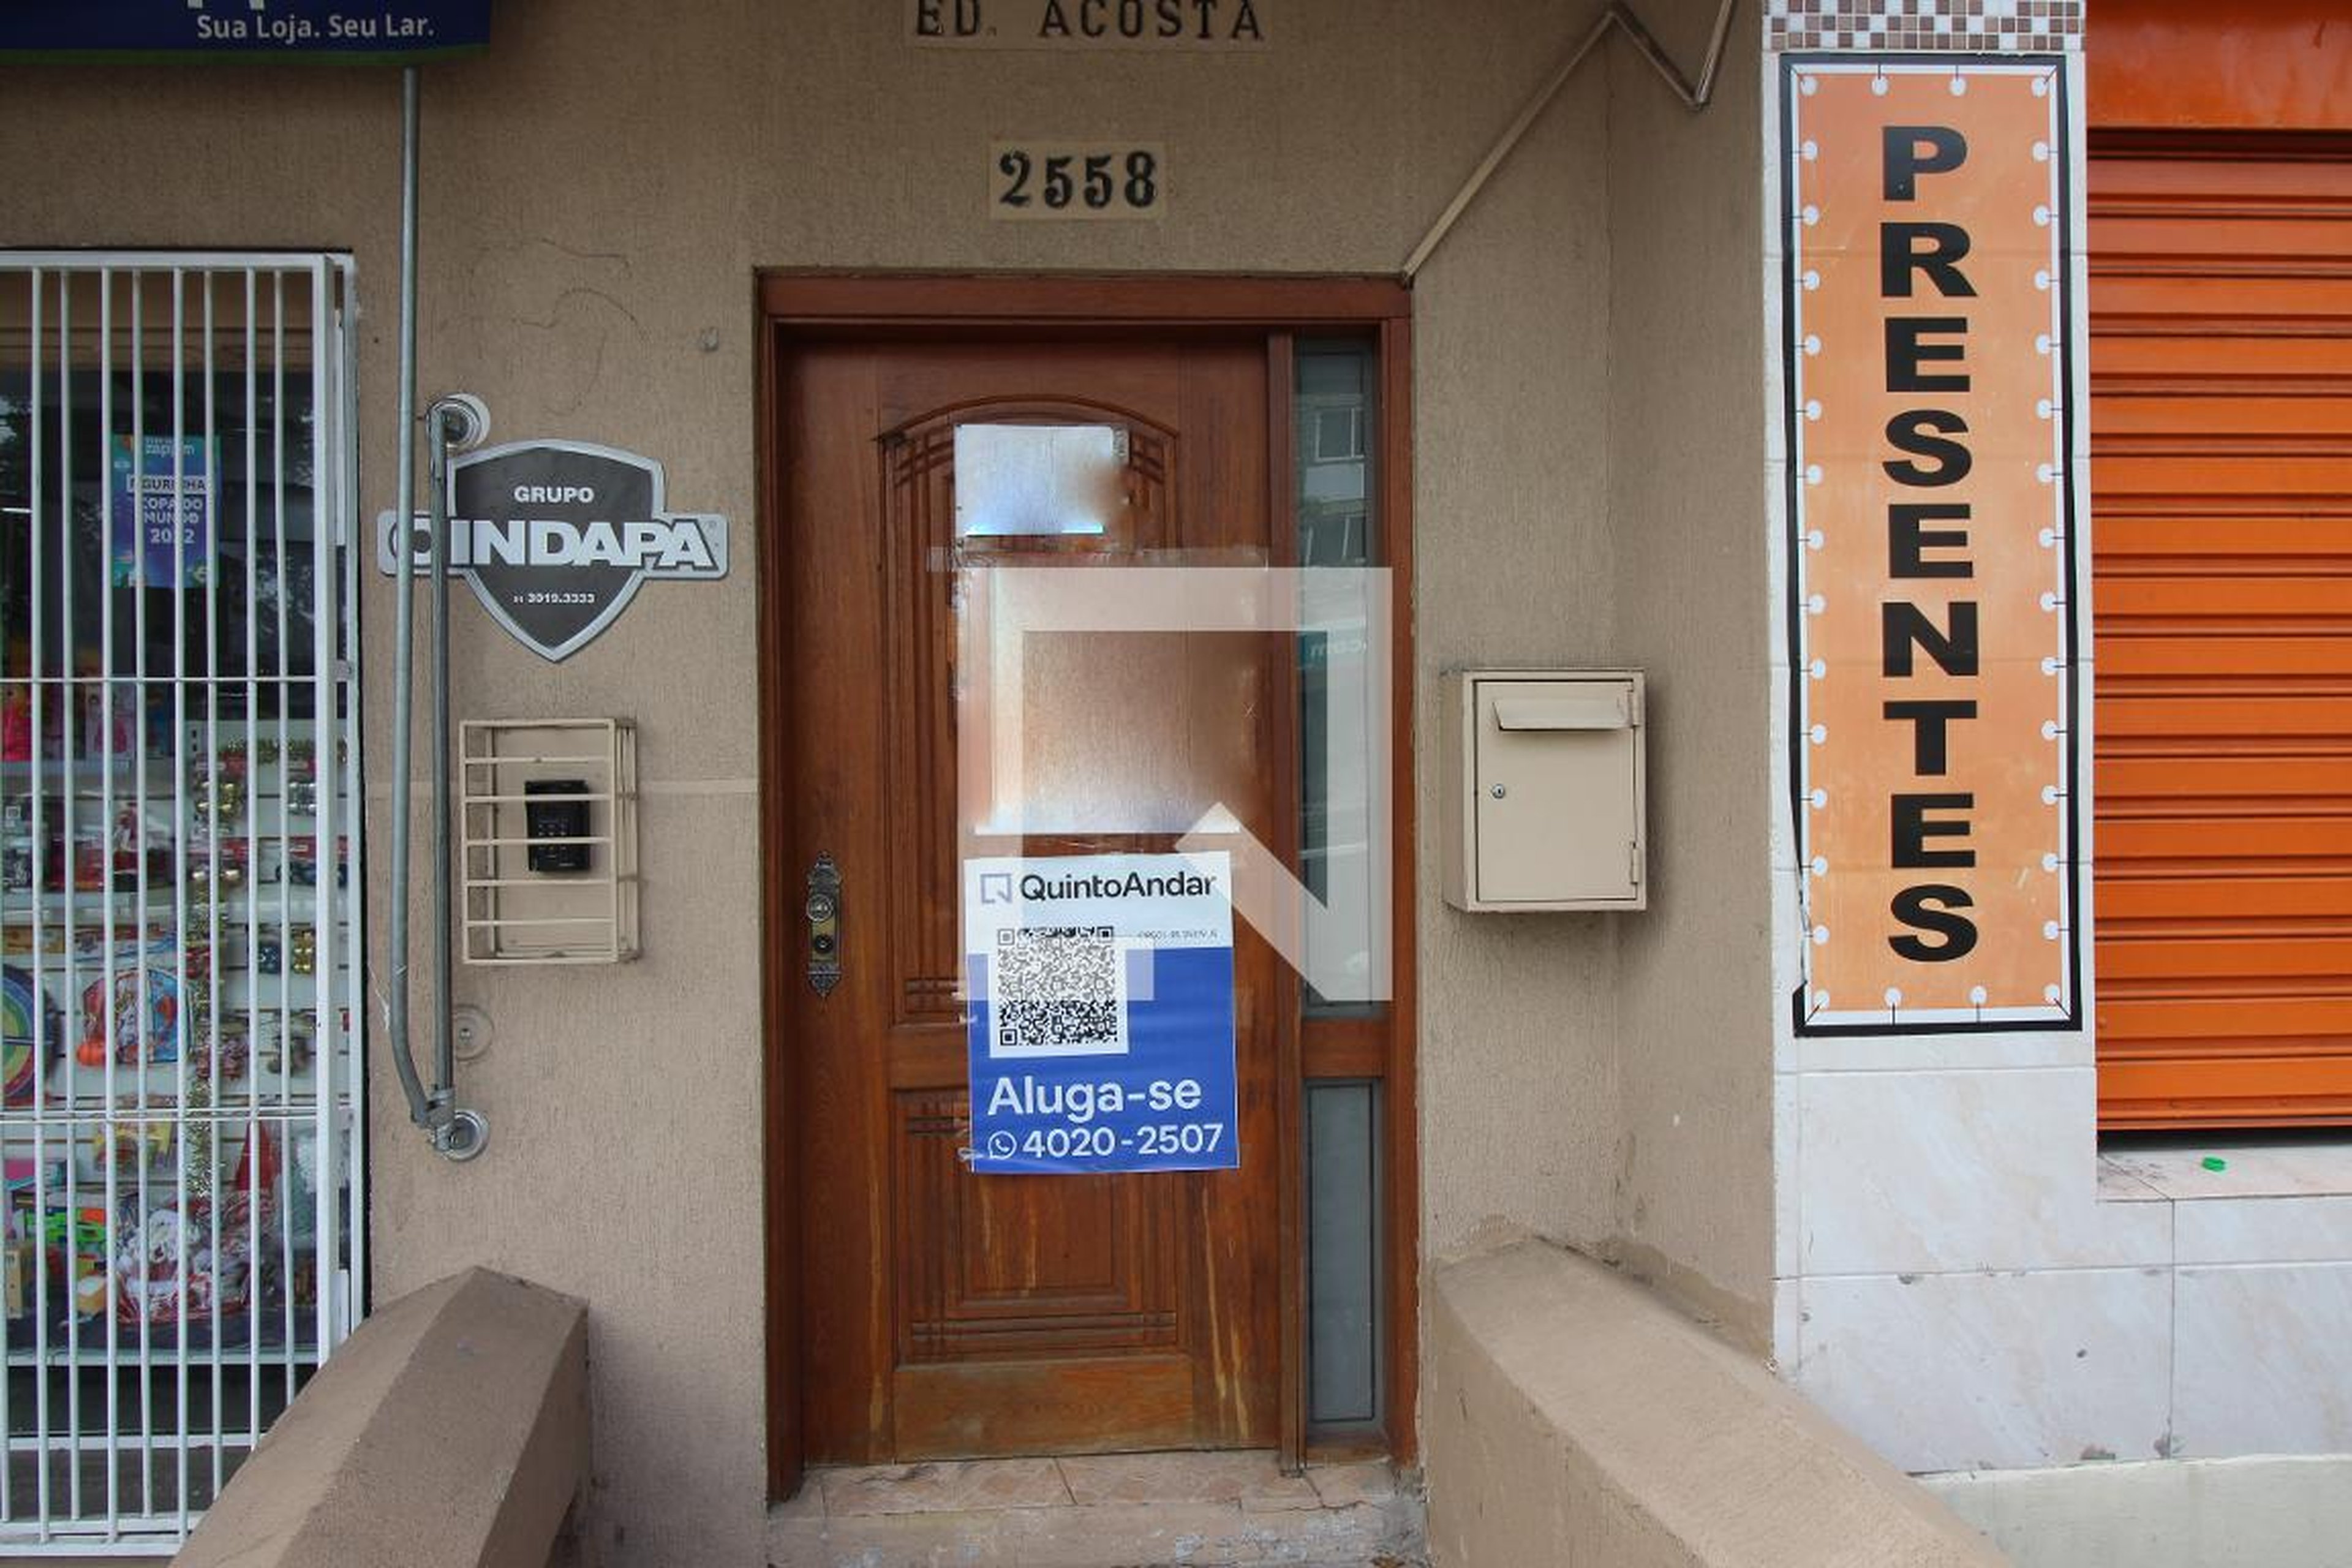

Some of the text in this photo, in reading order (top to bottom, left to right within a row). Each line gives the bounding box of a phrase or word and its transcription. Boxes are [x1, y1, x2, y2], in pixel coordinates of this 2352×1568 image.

[197, 13, 434, 44] Sua Loja. Seu Lar.
[1039, 0, 1264, 40] ACOSTA
[999, 151, 1156, 208] 2558
[514, 486, 594, 503] GRUPO
[150, 528, 195, 544] 202
[1880, 126, 1979, 962] PRESENTES
[1020, 871, 1216, 900] QuintoAndar
[987, 1076, 1202, 1123] Aluga-se
